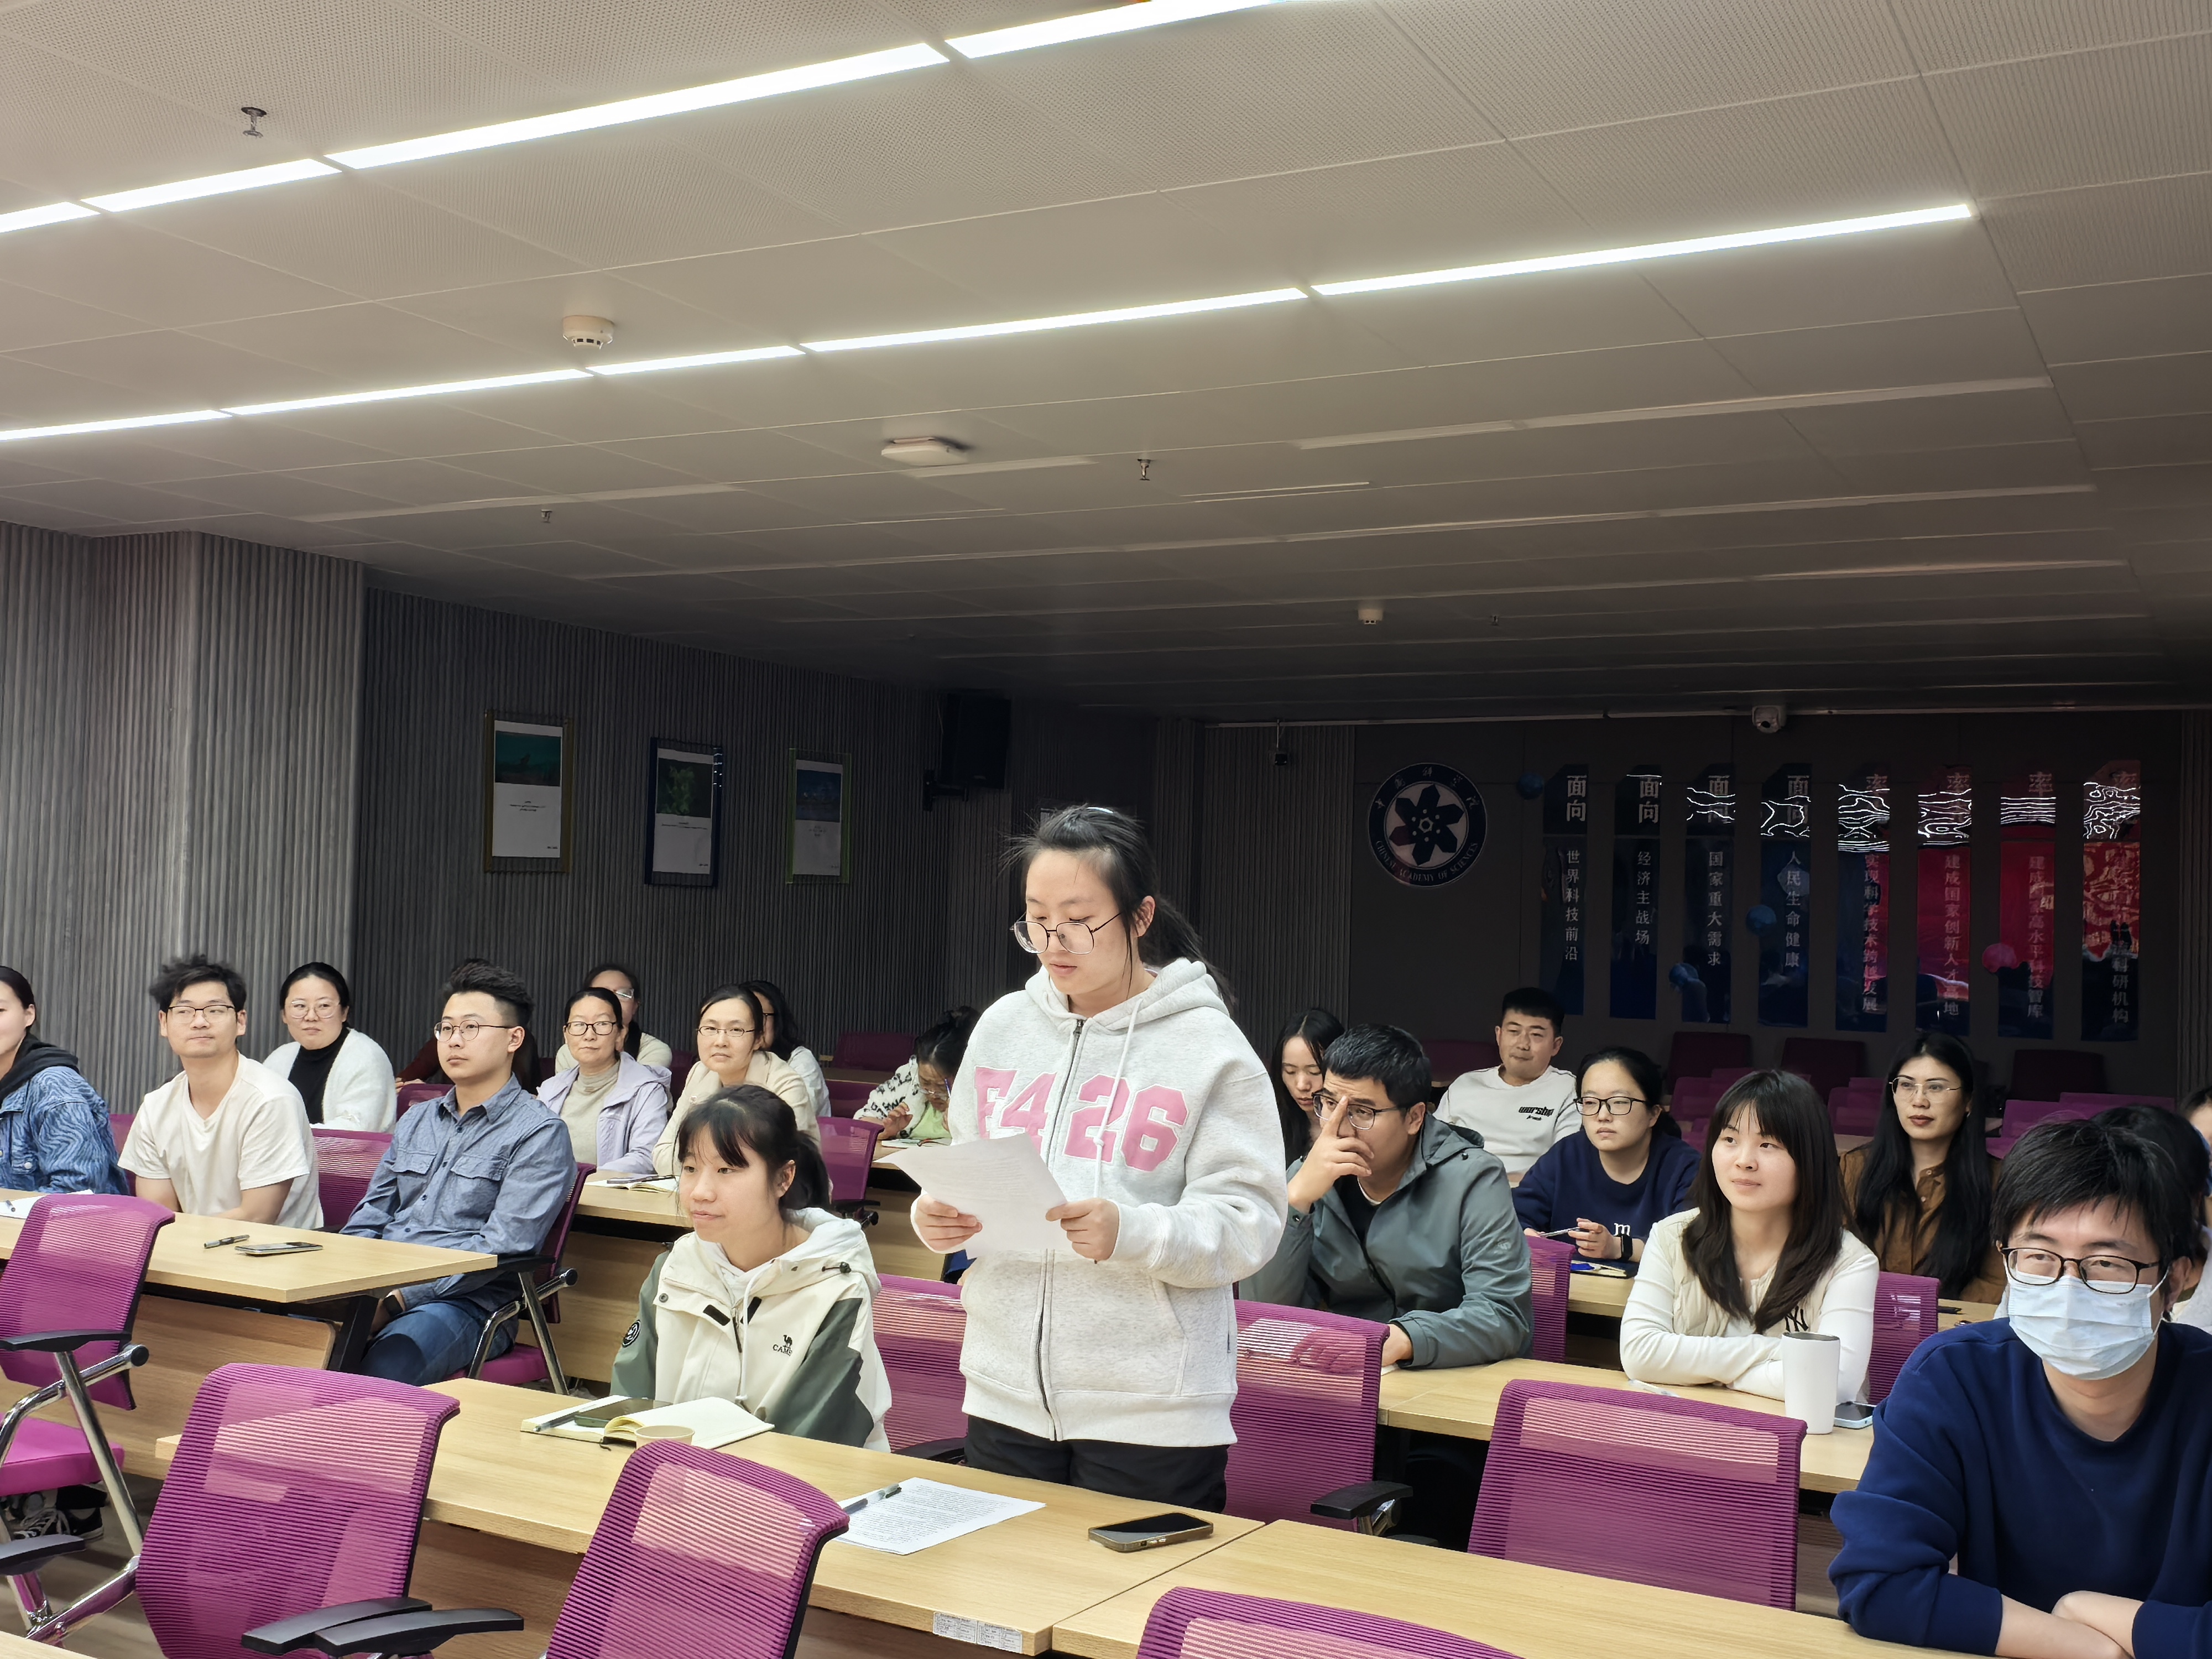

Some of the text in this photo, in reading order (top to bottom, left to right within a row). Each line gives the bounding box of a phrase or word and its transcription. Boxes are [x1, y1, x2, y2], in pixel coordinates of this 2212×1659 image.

[1567, 775, 1587, 822] 面向
[1639, 776, 1660, 823] 面向
[1566, 850, 1580, 961] 世界科技前沿
[1636, 851, 1651, 945] 经济主战场
[1708, 851, 1723, 966] 国家重大需求
[1785, 851, 1802, 968] 人民生命健康
